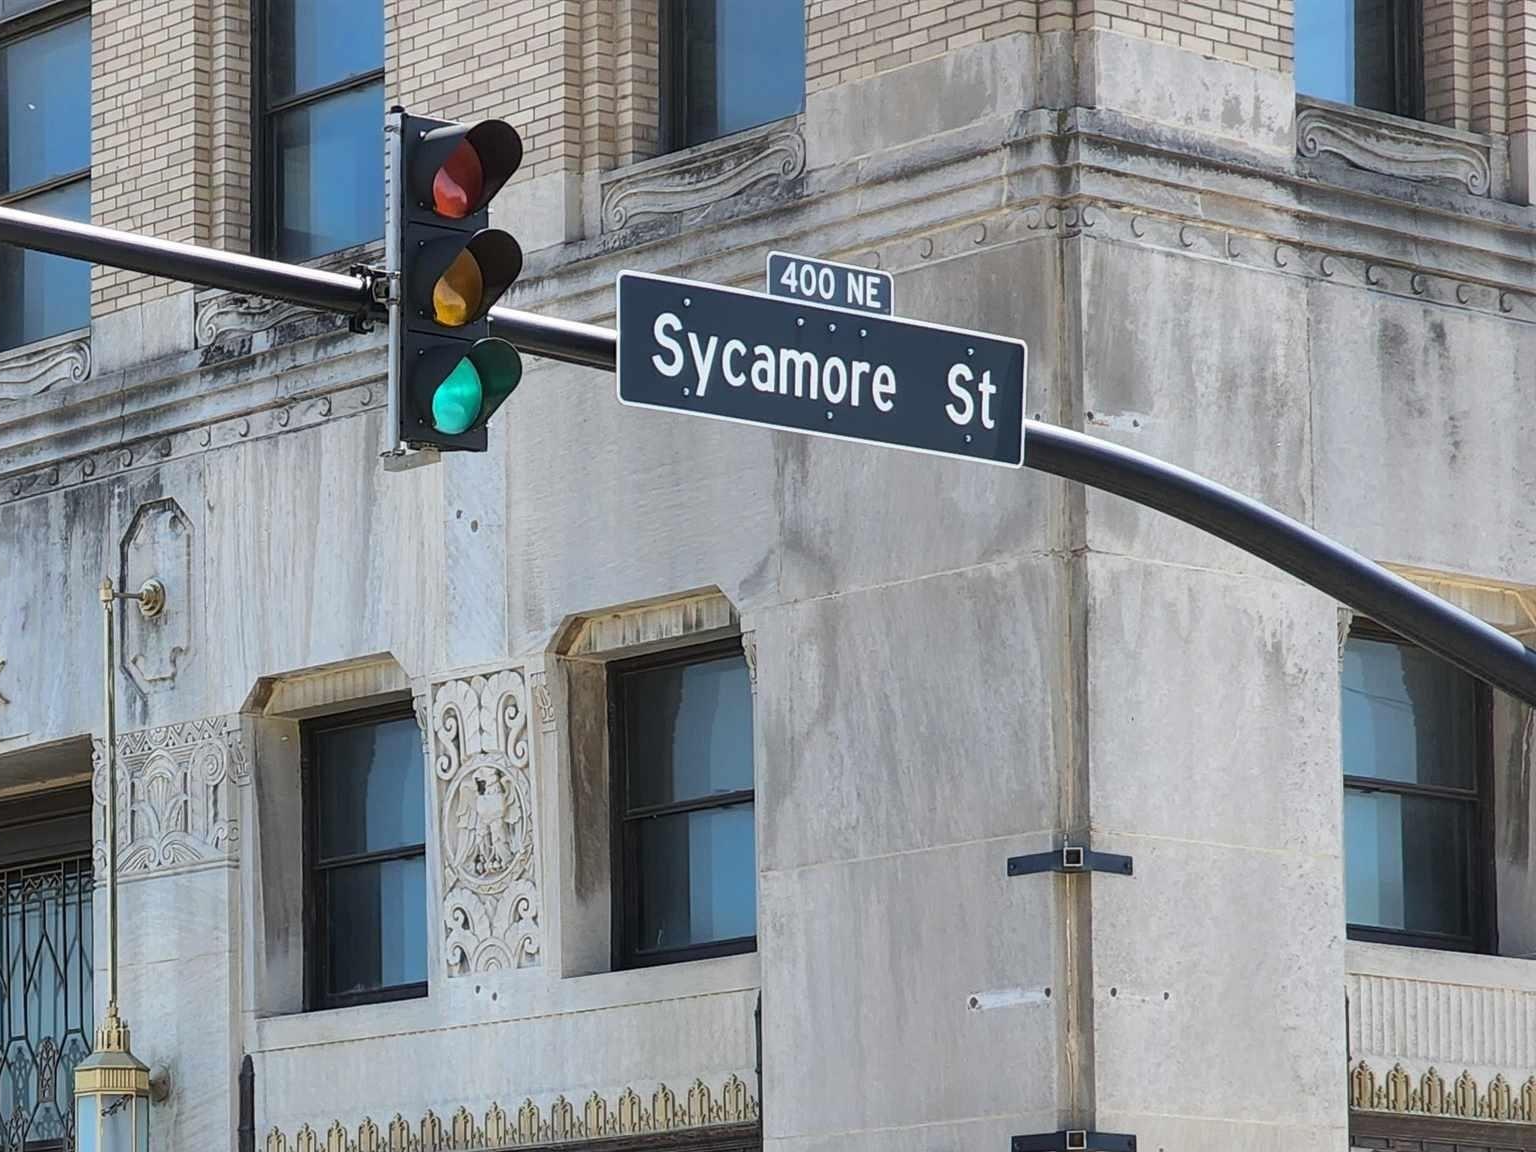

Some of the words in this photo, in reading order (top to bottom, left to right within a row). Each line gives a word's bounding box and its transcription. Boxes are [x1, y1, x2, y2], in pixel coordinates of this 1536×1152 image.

[779, 261, 836, 300] 400
[846, 272, 882, 309] NE
[651, 311, 897, 411] Sycamore
[945, 362, 997, 430] St
